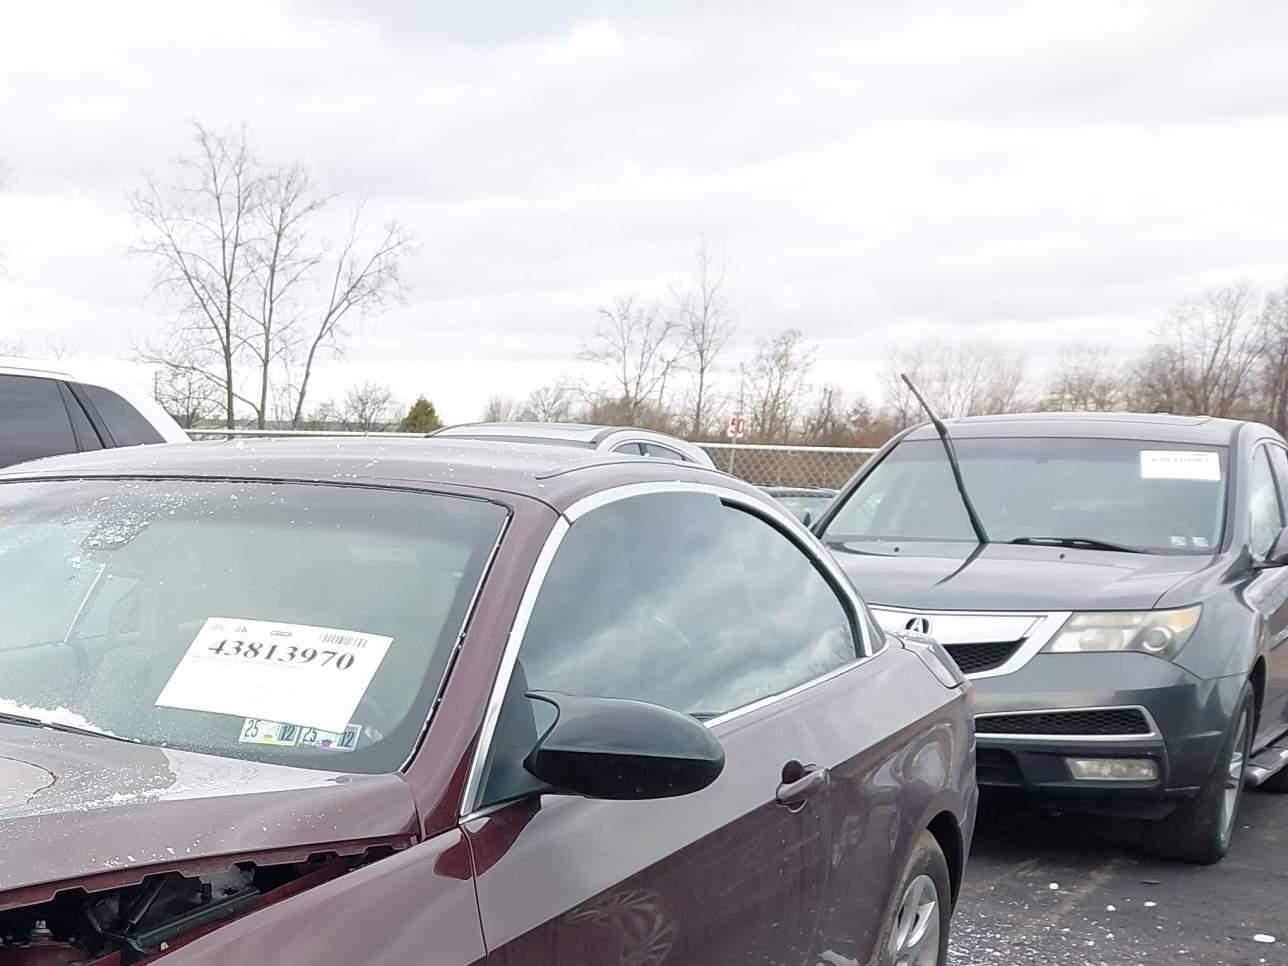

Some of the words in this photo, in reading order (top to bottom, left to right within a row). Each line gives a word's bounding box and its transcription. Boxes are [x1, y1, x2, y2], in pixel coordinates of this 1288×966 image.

[208, 639, 356, 670] 43813970
[244, 719, 260, 738] 25
[280, 725, 297, 742] 12
